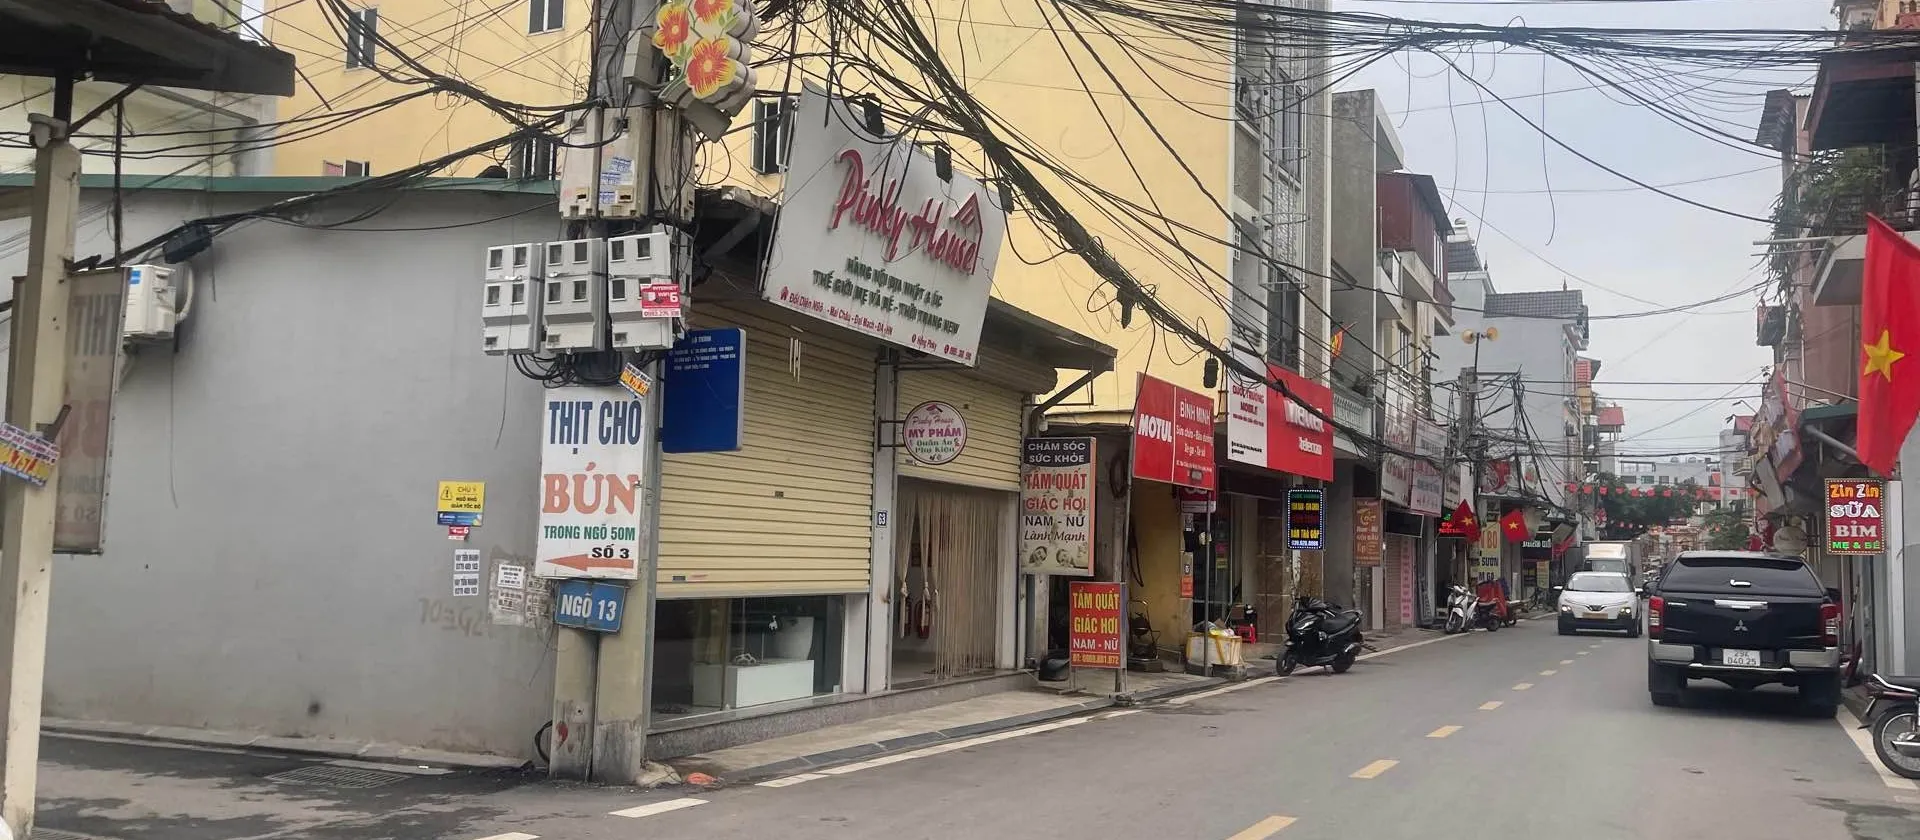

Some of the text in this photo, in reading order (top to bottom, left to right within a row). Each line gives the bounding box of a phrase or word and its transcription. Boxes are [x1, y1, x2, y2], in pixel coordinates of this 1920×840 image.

[829, 149, 977, 271] Pinky House
[847, 256, 872, 280] HÀNG
[813, 269, 834, 291] THẾ
[916, 309, 943, 330] TRANG
[943, 318, 961, 335] NEW
[1180, 398, 1195, 421] BÌNH
[1195, 405, 1211, 426] MINH
[548, 401, 593, 455] THỊT
[1138, 413, 1173, 443] MOTUL
[1063, 440, 1086, 450] SÓC
[1029, 452, 1085, 463] SỨC KHỎE
[1055, 467, 1087, 491] QUẤT
[542, 461, 640, 516] BÚN
[1830, 484, 1880, 498] Zin Zin
[1025, 494, 1058, 511] GIÁC
[1830, 500, 1881, 518] SỮA
[1025, 516, 1053, 526] NAM
[1835, 520, 1878, 538] BỈM
[543, 525, 581, 541] TRONG
[610, 526, 636, 542] 50M
[1024, 530, 1085, 544] Lành Mạnh
[592, 543, 630, 560] SỐ 3
[1832, 540, 1881, 551] MẸ & BÉ
[560, 593, 617, 622] NGÕ 13
[1095, 588, 1120, 611] QUẤT
[1074, 614, 1118, 635] GIÁC HƠI
[1073, 638, 1096, 650] NAM
[1104, 638, 1118, 650] NỮ
